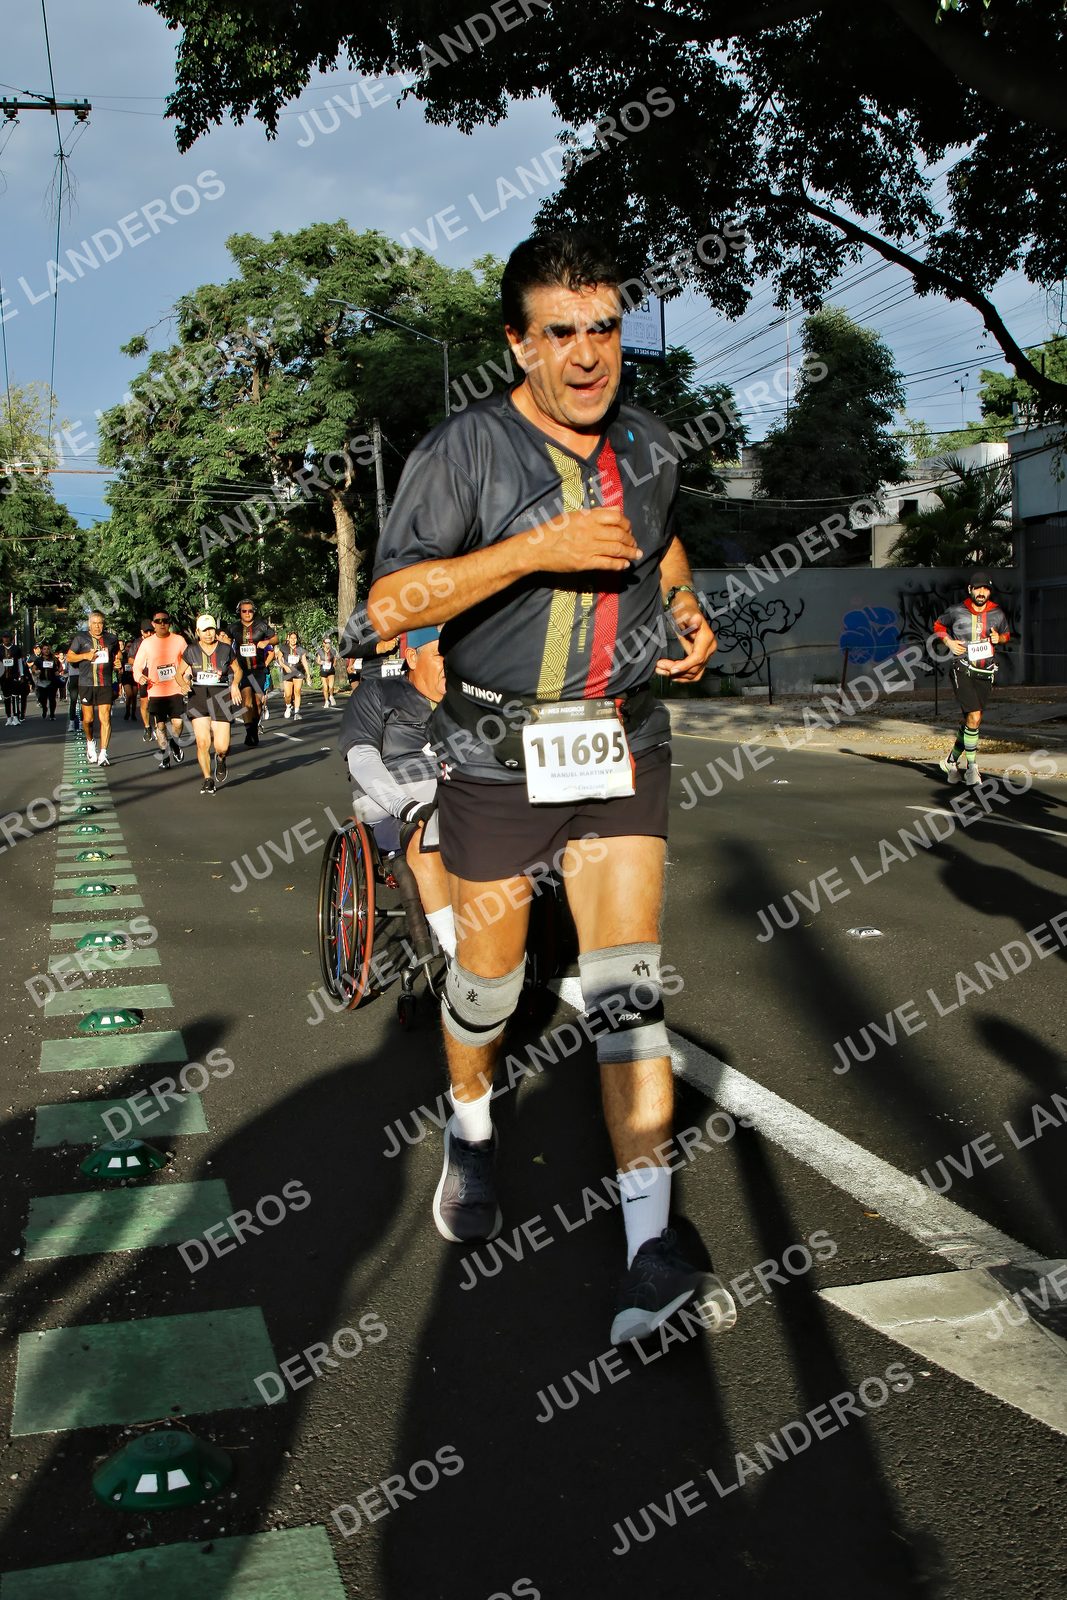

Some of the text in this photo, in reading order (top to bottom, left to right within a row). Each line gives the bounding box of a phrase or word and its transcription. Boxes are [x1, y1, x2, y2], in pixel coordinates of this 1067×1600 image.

[971, 645, 988, 654] 9400
[159, 668, 174, 676] 9271
[531, 731, 624, 768] 11695
